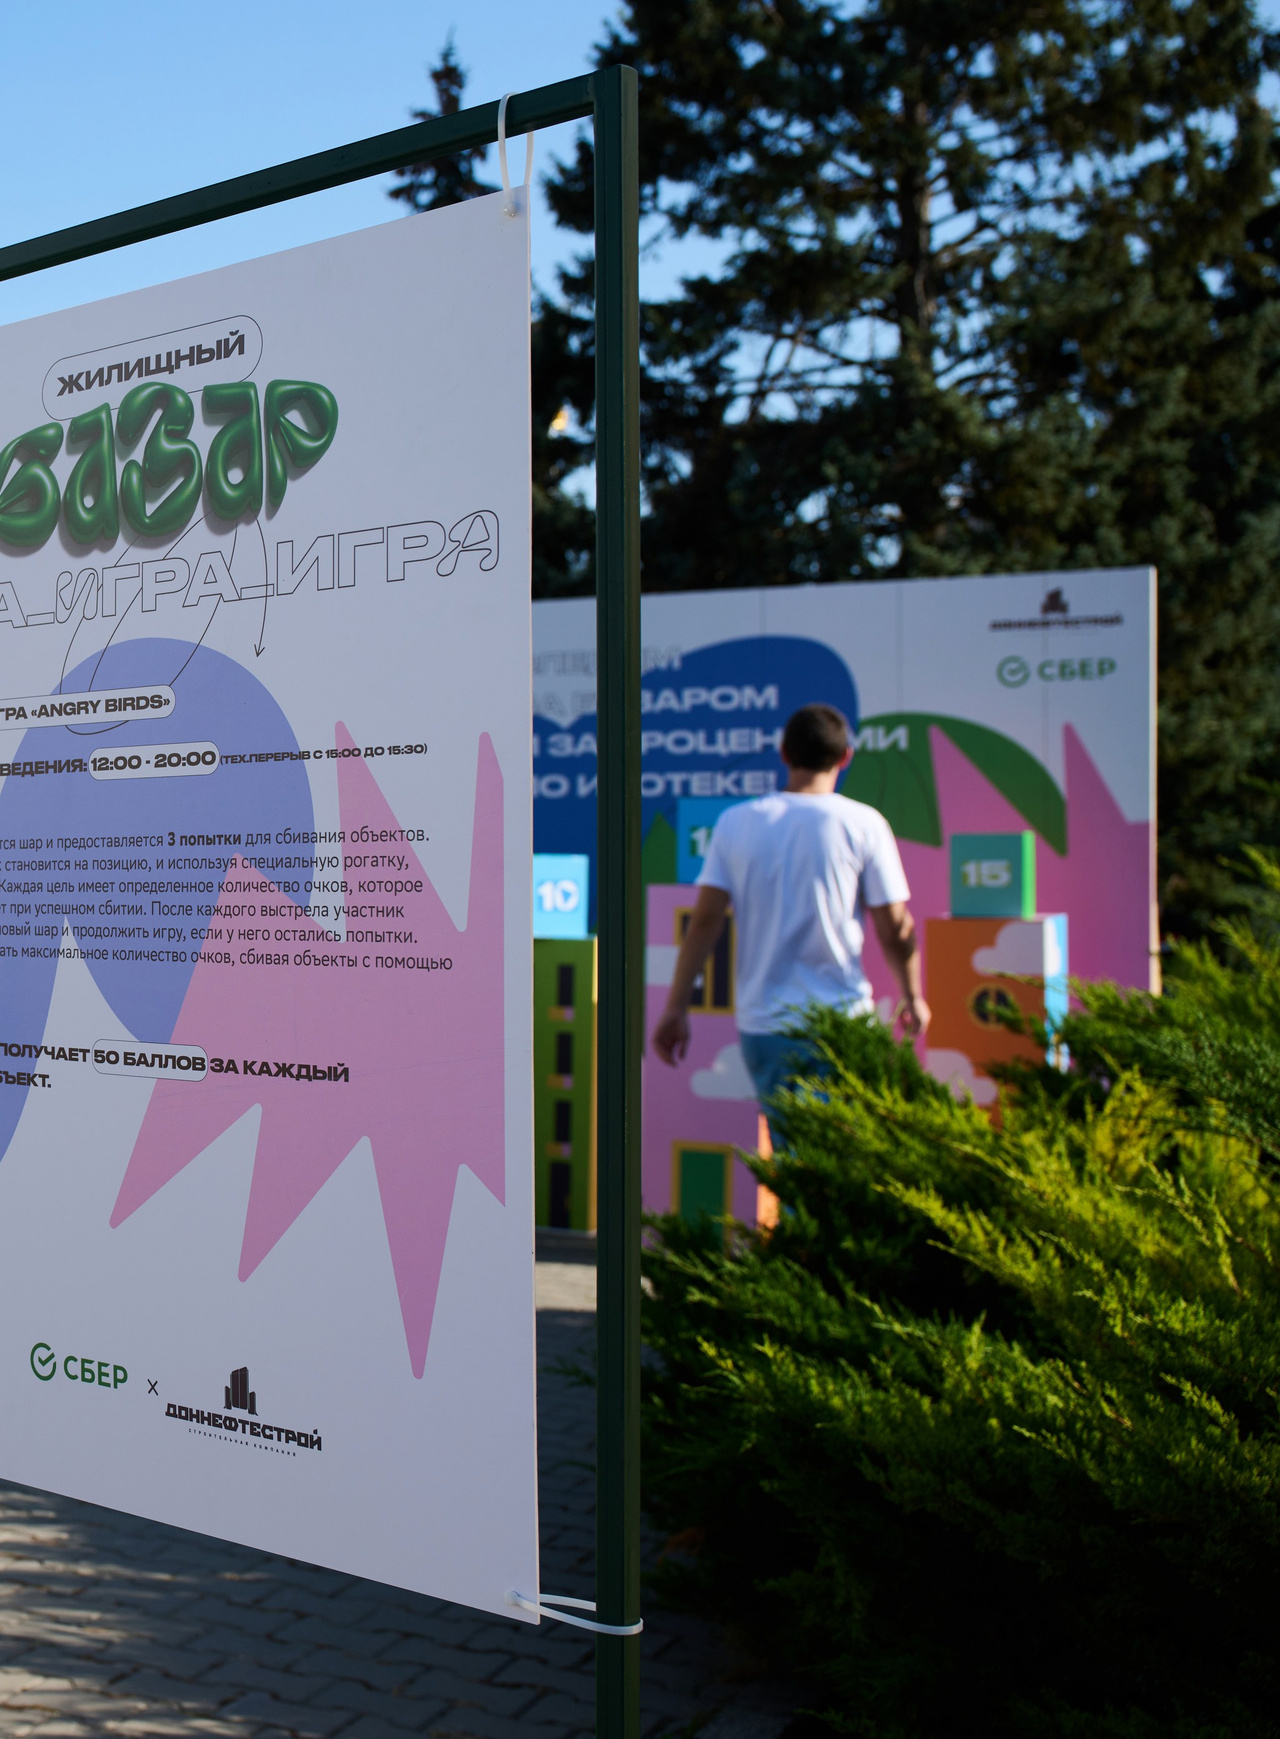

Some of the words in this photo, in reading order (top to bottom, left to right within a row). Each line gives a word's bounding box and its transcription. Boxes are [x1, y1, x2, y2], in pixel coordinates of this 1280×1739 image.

[56, 330, 245, 397] ЖИЛИЩНЫЙ
[1037, 656, 1117, 683] СБЕР
[31, 700, 101, 718] «ANGRY
[104, 694, 170, 712] BIRDS»
[641, 724, 909, 757] РОЦЕНМИ
[91, 755, 142, 771] 12:00
[154, 751, 217, 768] 20:00
[313, 750, 323, 759] С
[325, 748, 362, 759] 15:00
[364, 746, 385, 758] ДО
[387, 743, 428, 756] 15:30)
[533, 775, 569, 798] О
[577, 771, 776, 798] ИОТЕКЕ!
[20, 838, 43, 852] шар
[46, 838, 53, 849] и
[57, 835, 164, 851] предоставляется
[168, 831, 176, 846] 3
[180, 834, 241, 846] попытки
[245, 833, 271, 846] для
[275, 828, 346, 844] сбивания
[350, 825, 430, 843] объектов.
[5, 859, 71, 871] становится
[74, 860, 88, 870] на
[92, 858, 152, 872] позицию,
[156, 858, 164, 869] и
[168, 857, 237, 872] используя
[241, 856, 339, 871] специальную
[344, 855, 409, 871] рогатку,
[961, 859, 1012, 888] 15
[46, 882, 75, 894] цель
[78, 881, 115, 892] имеет
[118, 881, 214, 896] определенное
[217, 880, 300, 892] количество
[304, 880, 353, 896] очков,
[358, 880, 423, 896] которое
[537, 879, 580, 913] 10
[10, 903, 31, 917] при
[35, 903, 95, 917] успешном
[98, 900, 147, 916] сбитии.
[151, 901, 193, 916] После
[196, 904, 256, 918] каждого
[260, 904, 329, 920] выстрела
[333, 904, 405, 920] участник
[34, 925, 59, 939] шар
[62, 926, 69, 936] и
[72, 926, 149, 940] продолжить
[153, 928, 186, 942] игру,
[190, 928, 223, 940] если
[226, 928, 234, 943] у
[238, 928, 271, 941] него
[274, 928, 341, 942] остались
[346, 930, 418, 943] попытки.
[21, 946, 109, 960] максимальное
[112, 949, 187, 963] количество
[191, 952, 235, 966] очков,
[239, 948, 289, 966] сбивая
[293, 949, 358, 967] объекты
[362, 955, 370, 967] с
[375, 956, 453, 972] помощью
[94, 1049, 120, 1065] 50
[123, 1052, 206, 1072] БАЛЛОВ
[210, 1057, 239, 1075] ЗА
[243, 1060, 350, 1083] КАЖДЫЙ
[63, 1355, 128, 1389] СБЕР
[165, 1402, 322, 1451] ДОННЕФТЕСТРОЙ
[188, 1428, 249, 1446] СТРОИТЕЛЬНАЯ
[253, 1443, 297, 1457] КОМПАНИЯ
